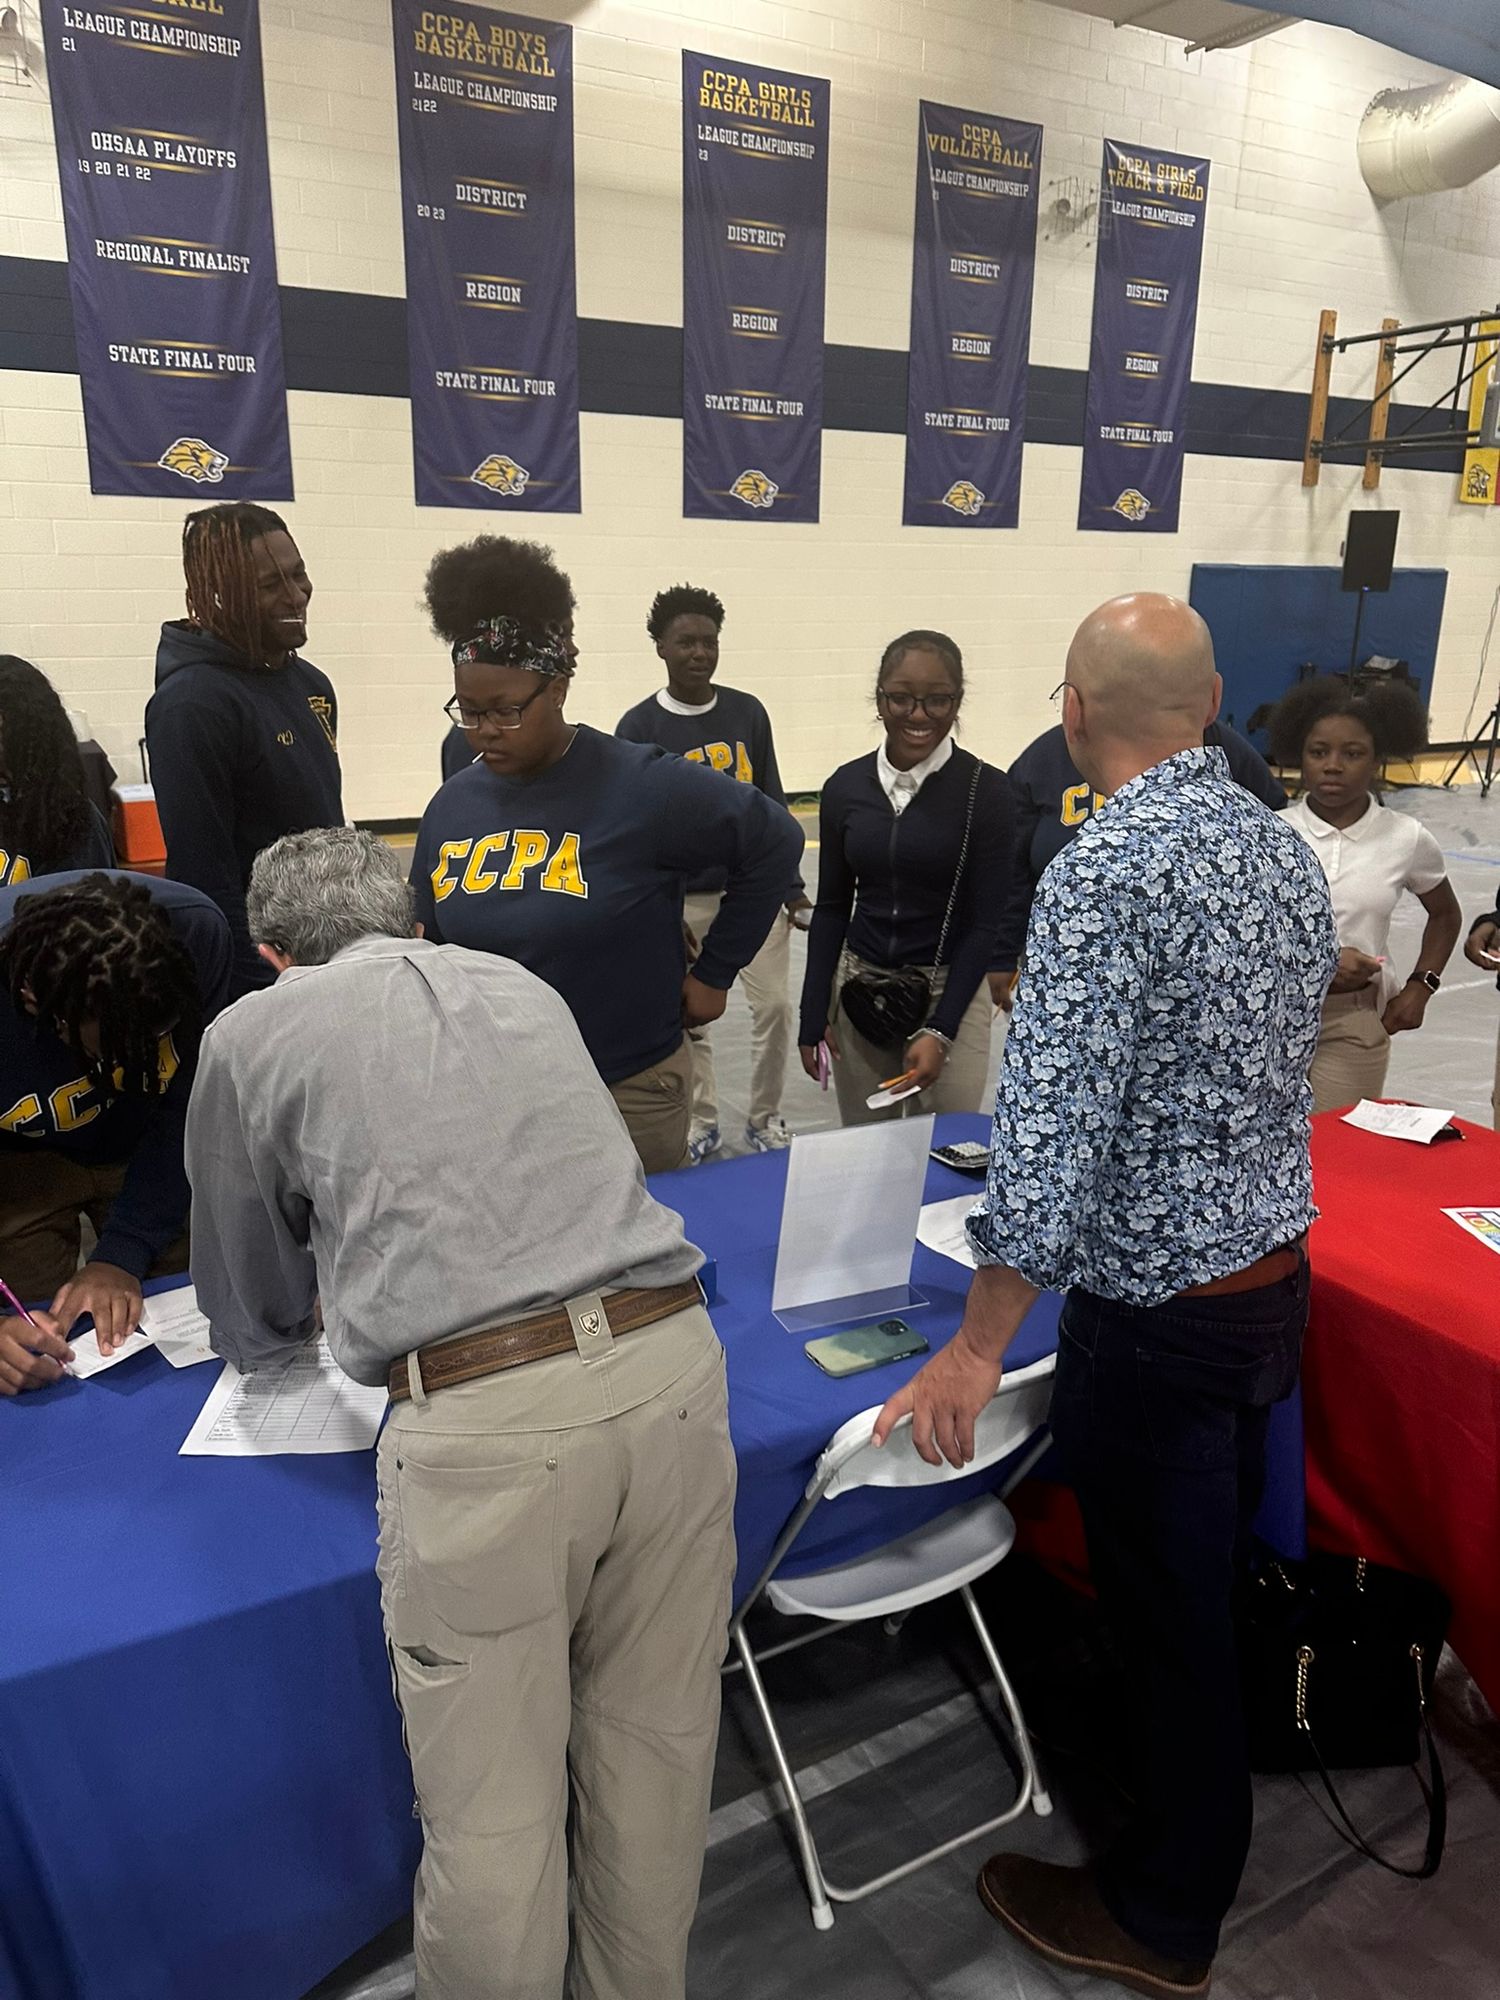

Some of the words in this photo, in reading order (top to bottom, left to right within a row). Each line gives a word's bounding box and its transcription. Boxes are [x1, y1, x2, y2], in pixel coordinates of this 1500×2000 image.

[62, 37, 76, 52] 21
[63, 7, 126, 38] LEAGUE
[130, 20, 241, 57] CHAMPIONSHIP
[421, 11, 481, 42] CCPA
[489, 25, 547, 56] BOYS
[414, 30, 556, 78] BASKETBALL
[413, 71, 464, 96] LEAGUE
[467, 82, 558, 112] CHAMPIONSHIP
[702, 69, 752, 97] CCPA
[758, 81, 812, 108] GIRLS
[699, 87, 815, 128] BASKETBALL
[697, 124, 739, 146] LEAGUE
[741, 132, 815, 160] CHAMPIONSHIP
[962, 123, 1002, 146] CCPA
[91, 131, 149, 157] OHSAA
[154, 140, 237, 169] PLAYOFFS
[927, 133, 1033, 169] VOLLEYBALL
[78, 159, 90, 174] 19
[95, 161, 111, 175] 20
[117, 163, 130, 178] 21
[135, 166, 152, 181] 22
[930, 166, 964, 187] LEAGUE
[966, 174, 1029, 198] CHAMPIONSHIP
[1157, 163, 1197, 184] GIRLS
[455, 183, 527, 210] DISTRICT
[1108, 168, 1152, 191] TRACK
[1156, 178, 1165, 194] &
[1170, 180, 1204, 202] FIELD
[417, 204, 430, 218] 20
[433, 207, 446, 221] 23
[1112, 200, 1141, 218] LEAGUE
[1142, 205, 1196, 227] CHAMPIONSHIP
[727, 225, 786, 248] DISTRICT
[95, 239, 174, 266] REGIONAL
[179, 250, 250, 274] FINALIST
[950, 258, 1000, 279] DISTRICT
[466, 281, 521, 304] REGION
[1126, 283, 1170, 302] DISTRICT
[732, 312, 778, 332] REGION
[108, 344, 160, 366] STATE
[165, 349, 213, 370] FINAL
[218, 354, 257, 373] FOUR
[952, 338, 991, 355] REGION
[1125, 357, 1159, 374] REGION
[435, 371, 477, 390] STATE
[480, 376, 520, 394] FINAL
[524, 379, 556, 396] FOUR
[705, 394, 740, 411] STATE
[742, 398, 774, 415] FINAL
[776, 401, 804, 417] FOUR
[924, 412, 955, 427] STATE
[957, 415, 983, 430] FINAL
[986, 417, 1010, 431] FOUR
[1100, 426, 1125, 441] STATE
[1126, 428, 1151, 442] FINAL
[1152, 431, 1174, 443] FOUR
[431, 829, 588, 903] CCPA
